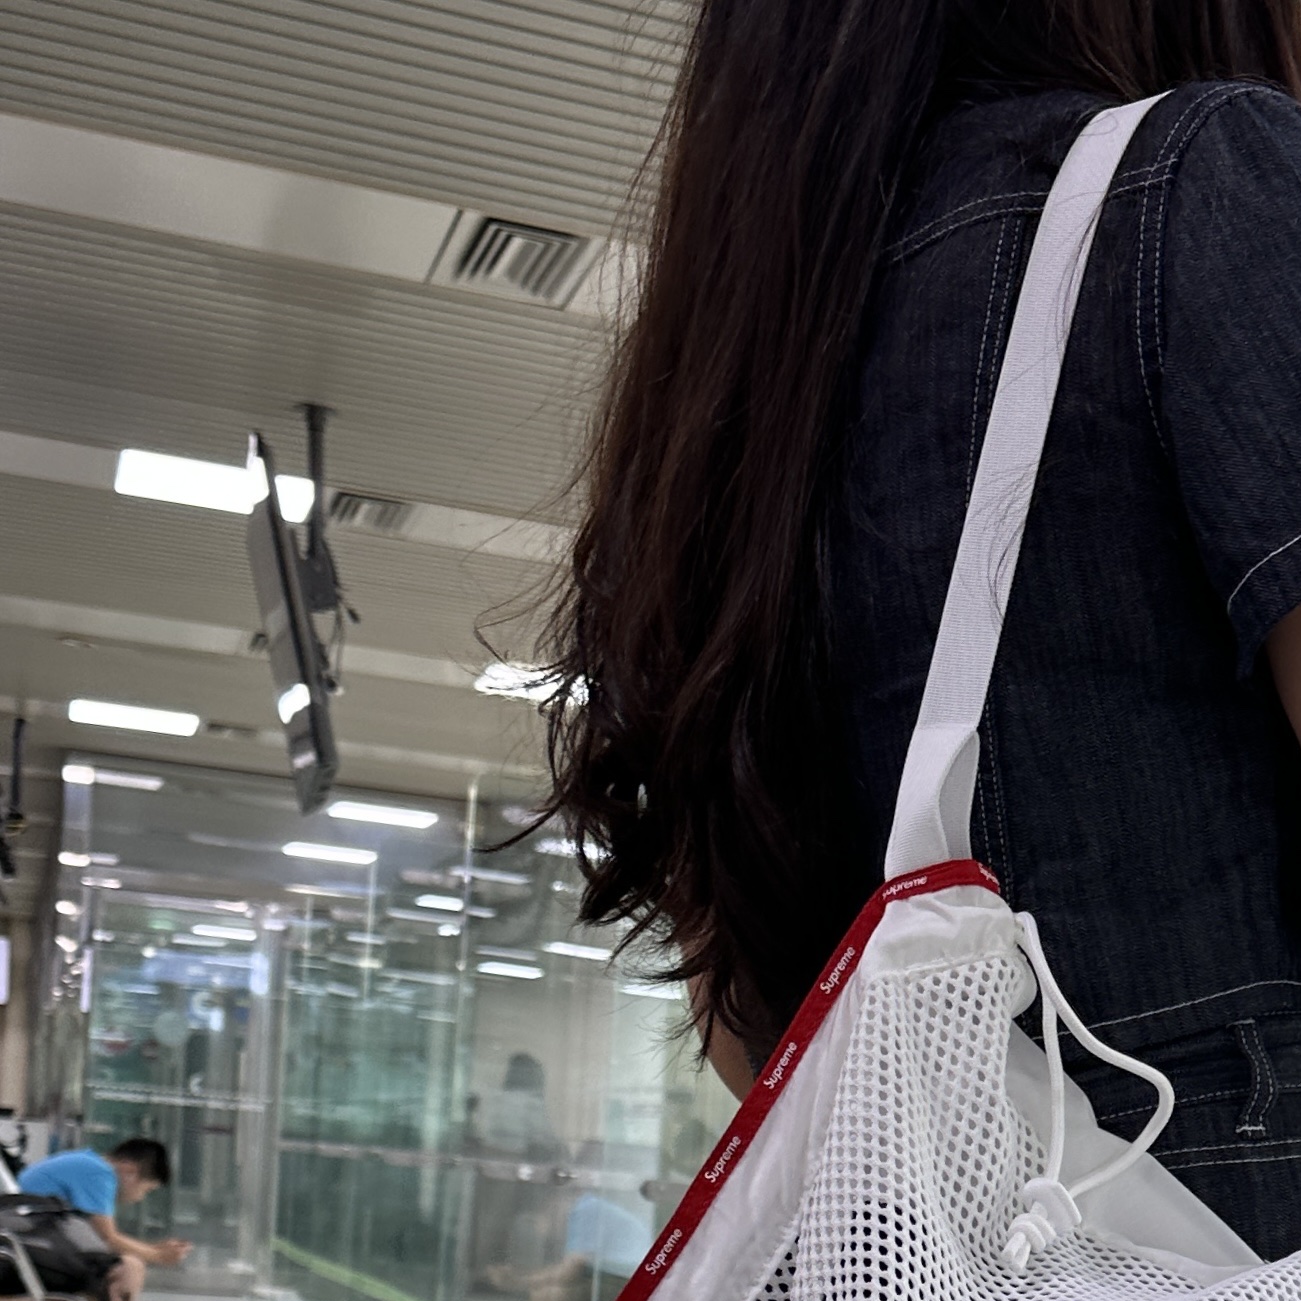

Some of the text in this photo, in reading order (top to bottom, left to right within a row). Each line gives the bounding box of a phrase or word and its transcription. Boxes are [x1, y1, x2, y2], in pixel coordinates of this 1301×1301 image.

[820, 946, 856, 995] Supreme
[763, 1042, 798, 1090] Supreme
[704, 1135, 742, 1183] Supreme
[645, 1228, 683, 1275] Supreme
